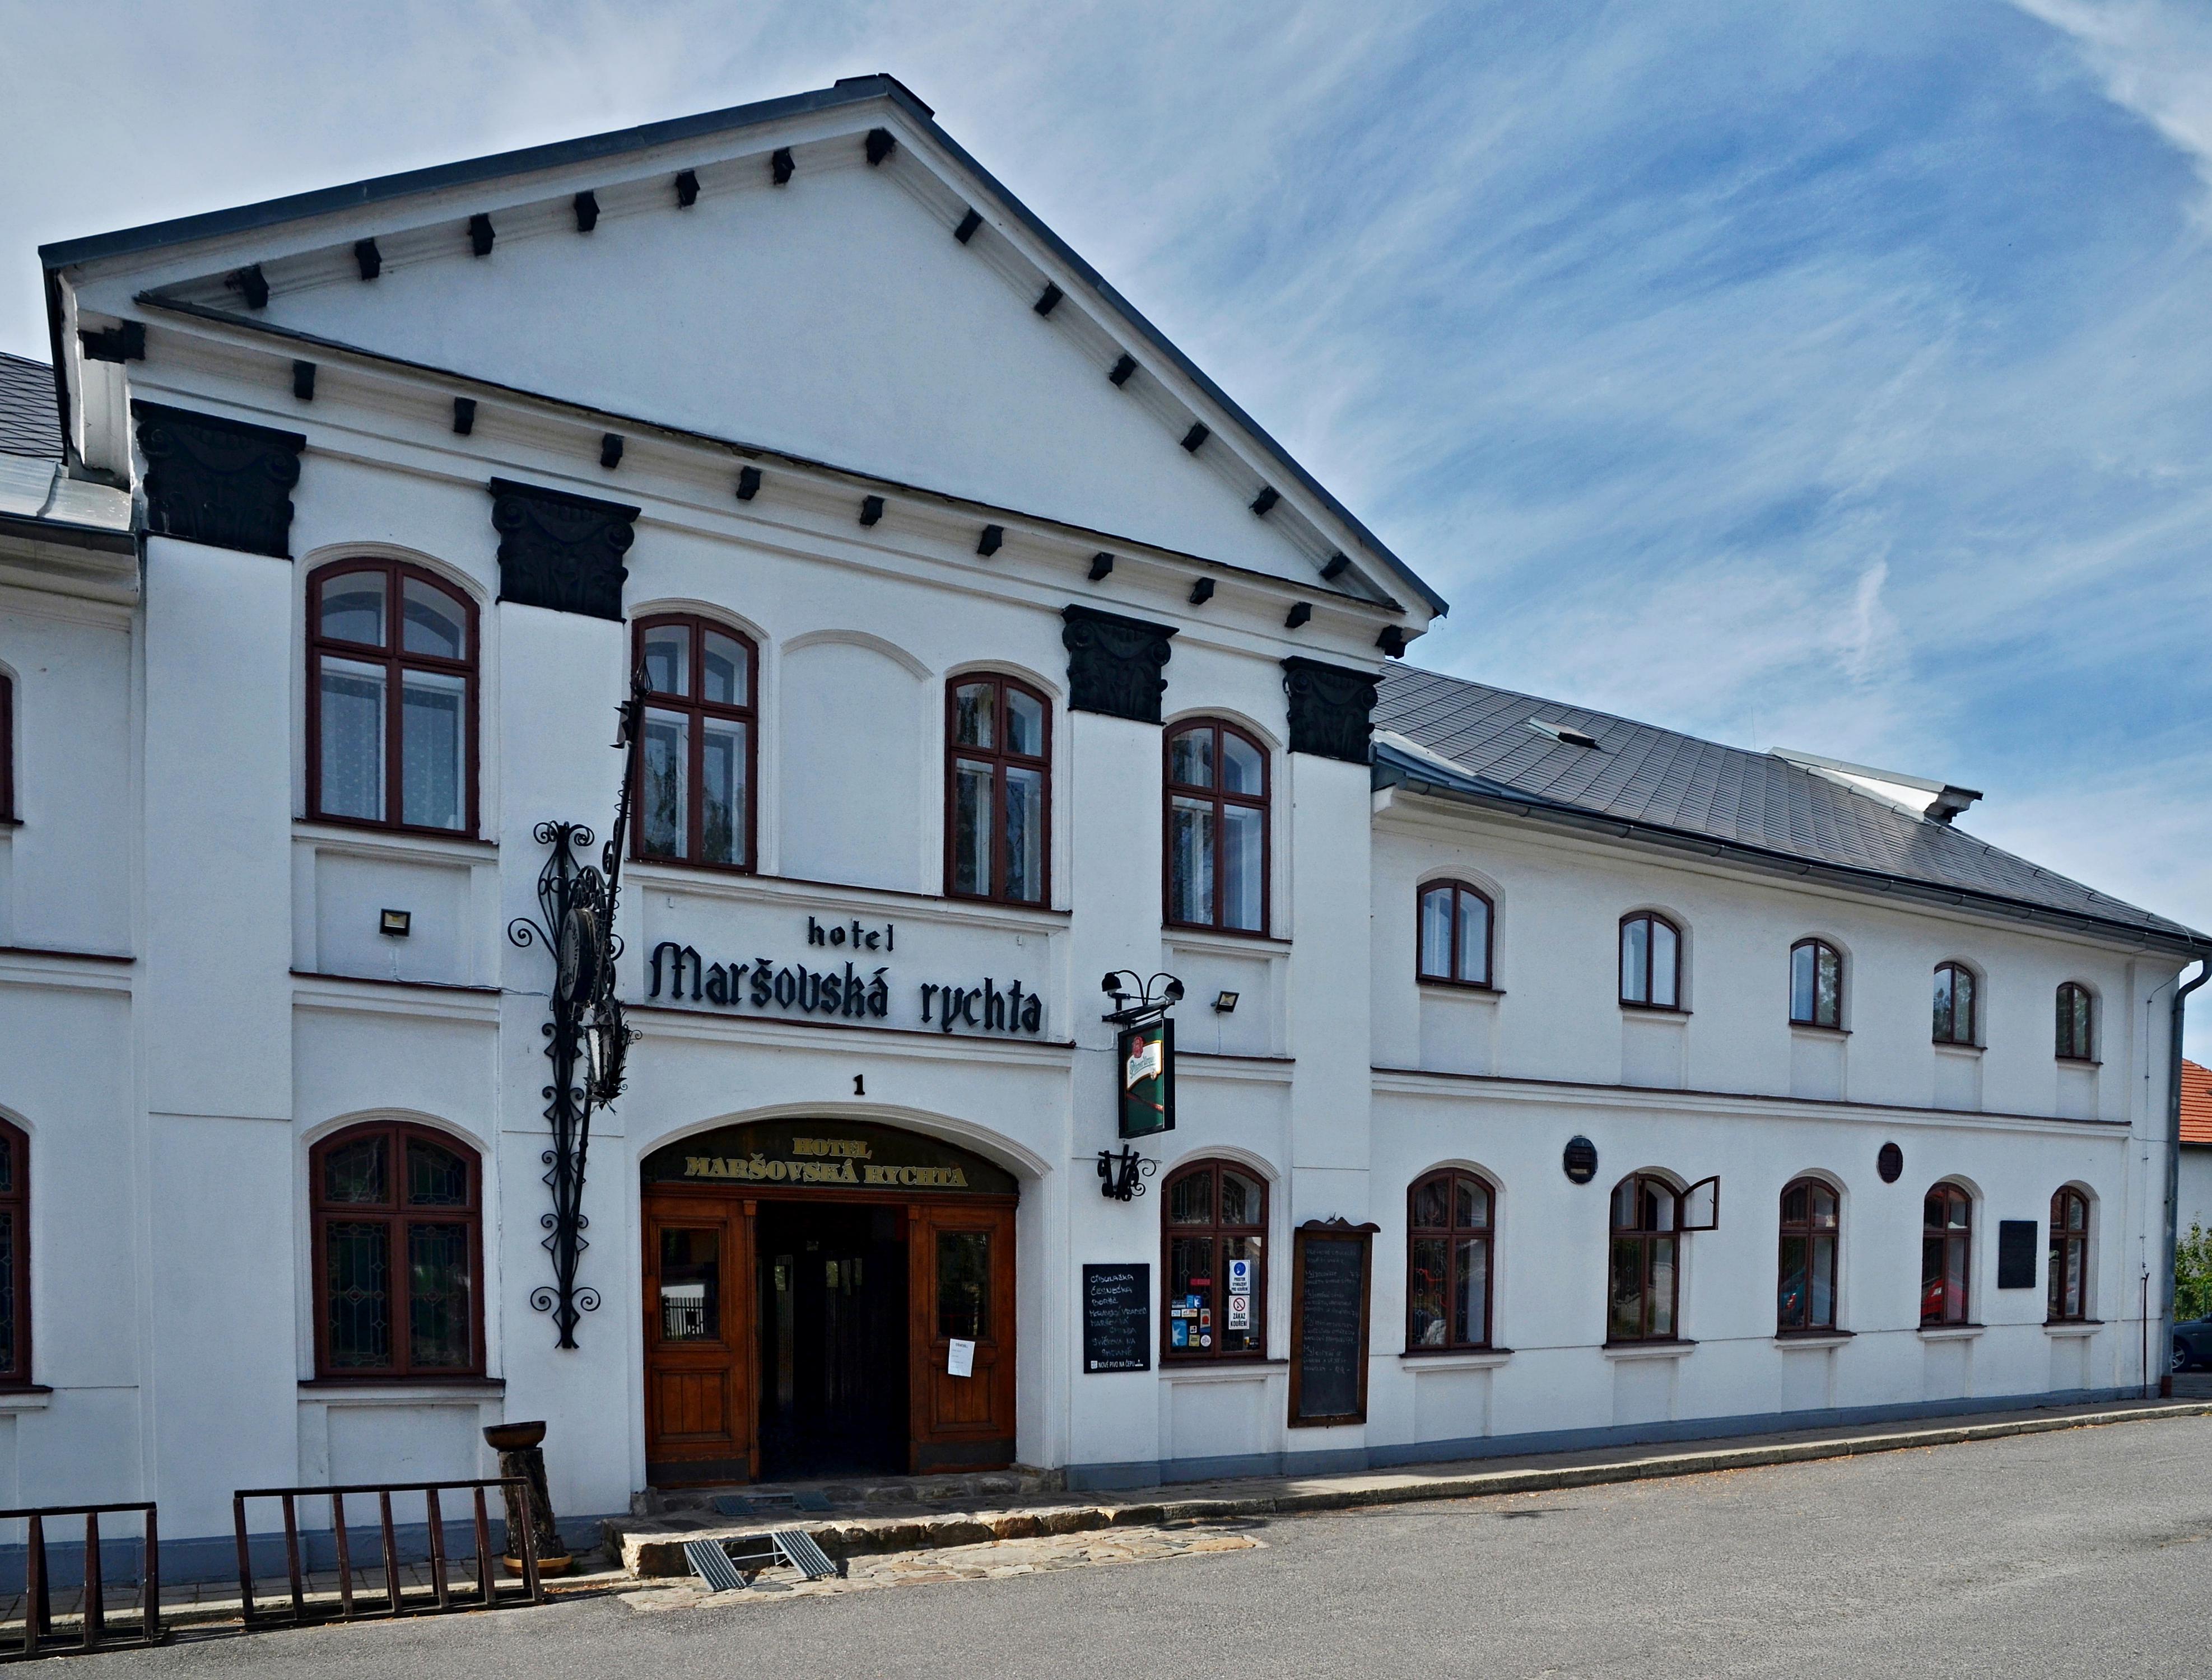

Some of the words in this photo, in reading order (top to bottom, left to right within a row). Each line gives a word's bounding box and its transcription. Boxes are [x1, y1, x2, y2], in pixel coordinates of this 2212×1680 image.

[808, 916, 894, 952] hotel
[650, 941, 890, 1018] Maršovská
[919, 977, 1042, 1033] rychta
[854, 1074, 865, 1095] 1
[792, 1137, 872, 1159] HOTEL
[684, 1152, 859, 1183] MARŠOVSKÁ
[864, 1165, 968, 1187] RYCHTA
